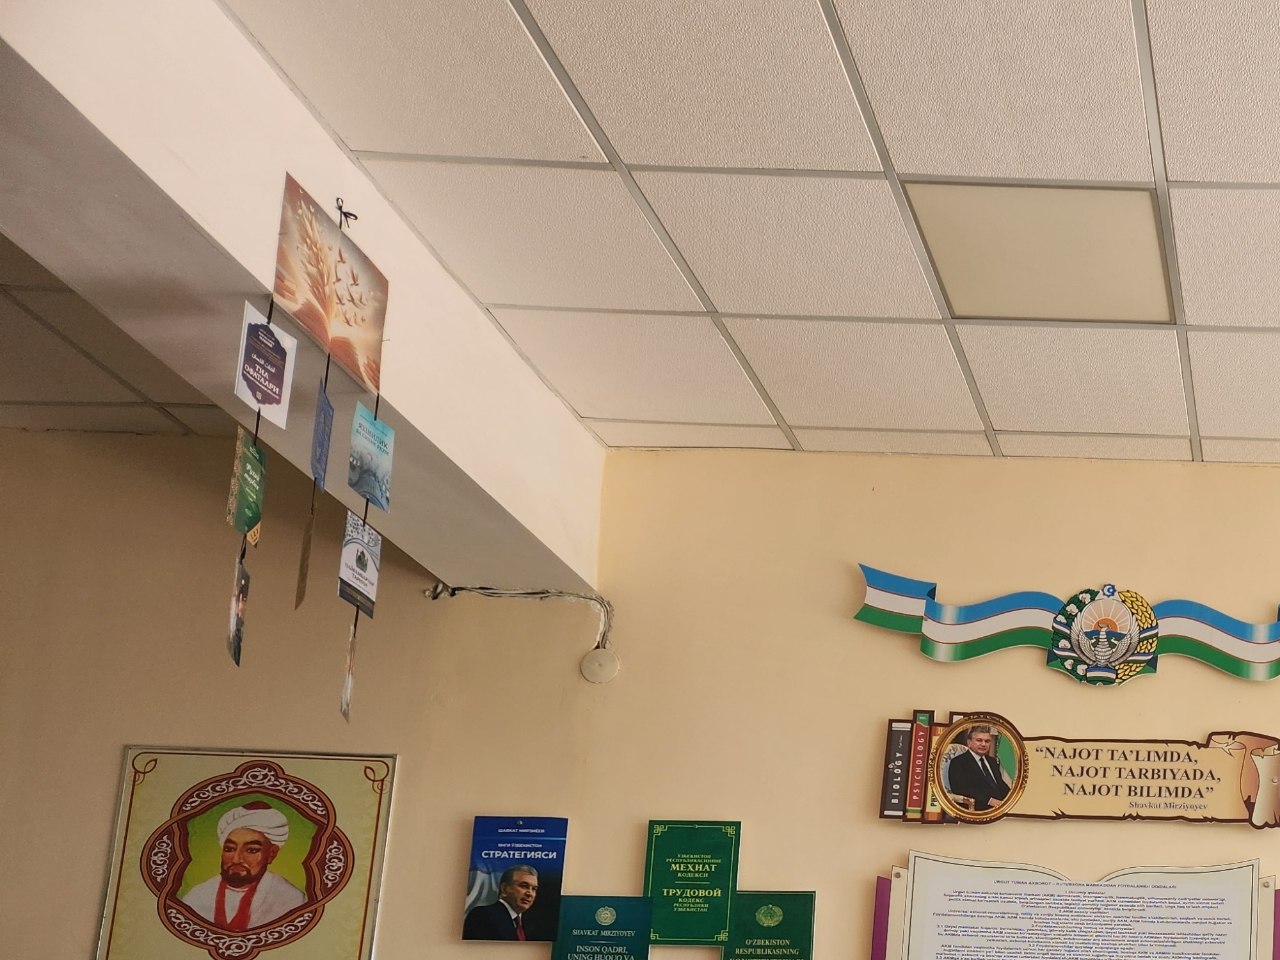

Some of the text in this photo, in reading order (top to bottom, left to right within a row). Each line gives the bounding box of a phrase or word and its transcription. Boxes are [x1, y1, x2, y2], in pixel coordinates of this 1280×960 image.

[1036, 747, 1198, 765] “NAJOT TA’LIMDA,
[912, 732, 925, 800] PSYCHOLOGY
[891, 752, 903, 804] BIOLOGY
[1051, 765, 1221, 783] NAJOT TARBIYADA,
[1064, 783, 1214, 798] NAJOT BILIMDA”
[1129, 801, 1208, 811] Shavkat Mirziyoyev
[481, 850, 557, 859] СТРАТЕГИЯСИ
[662, 888, 722, 897] ТРУДОВОЙ
[567, 953, 593, 960] UNING
[735, 947, 800, 956] RESPUBLIKASINING
